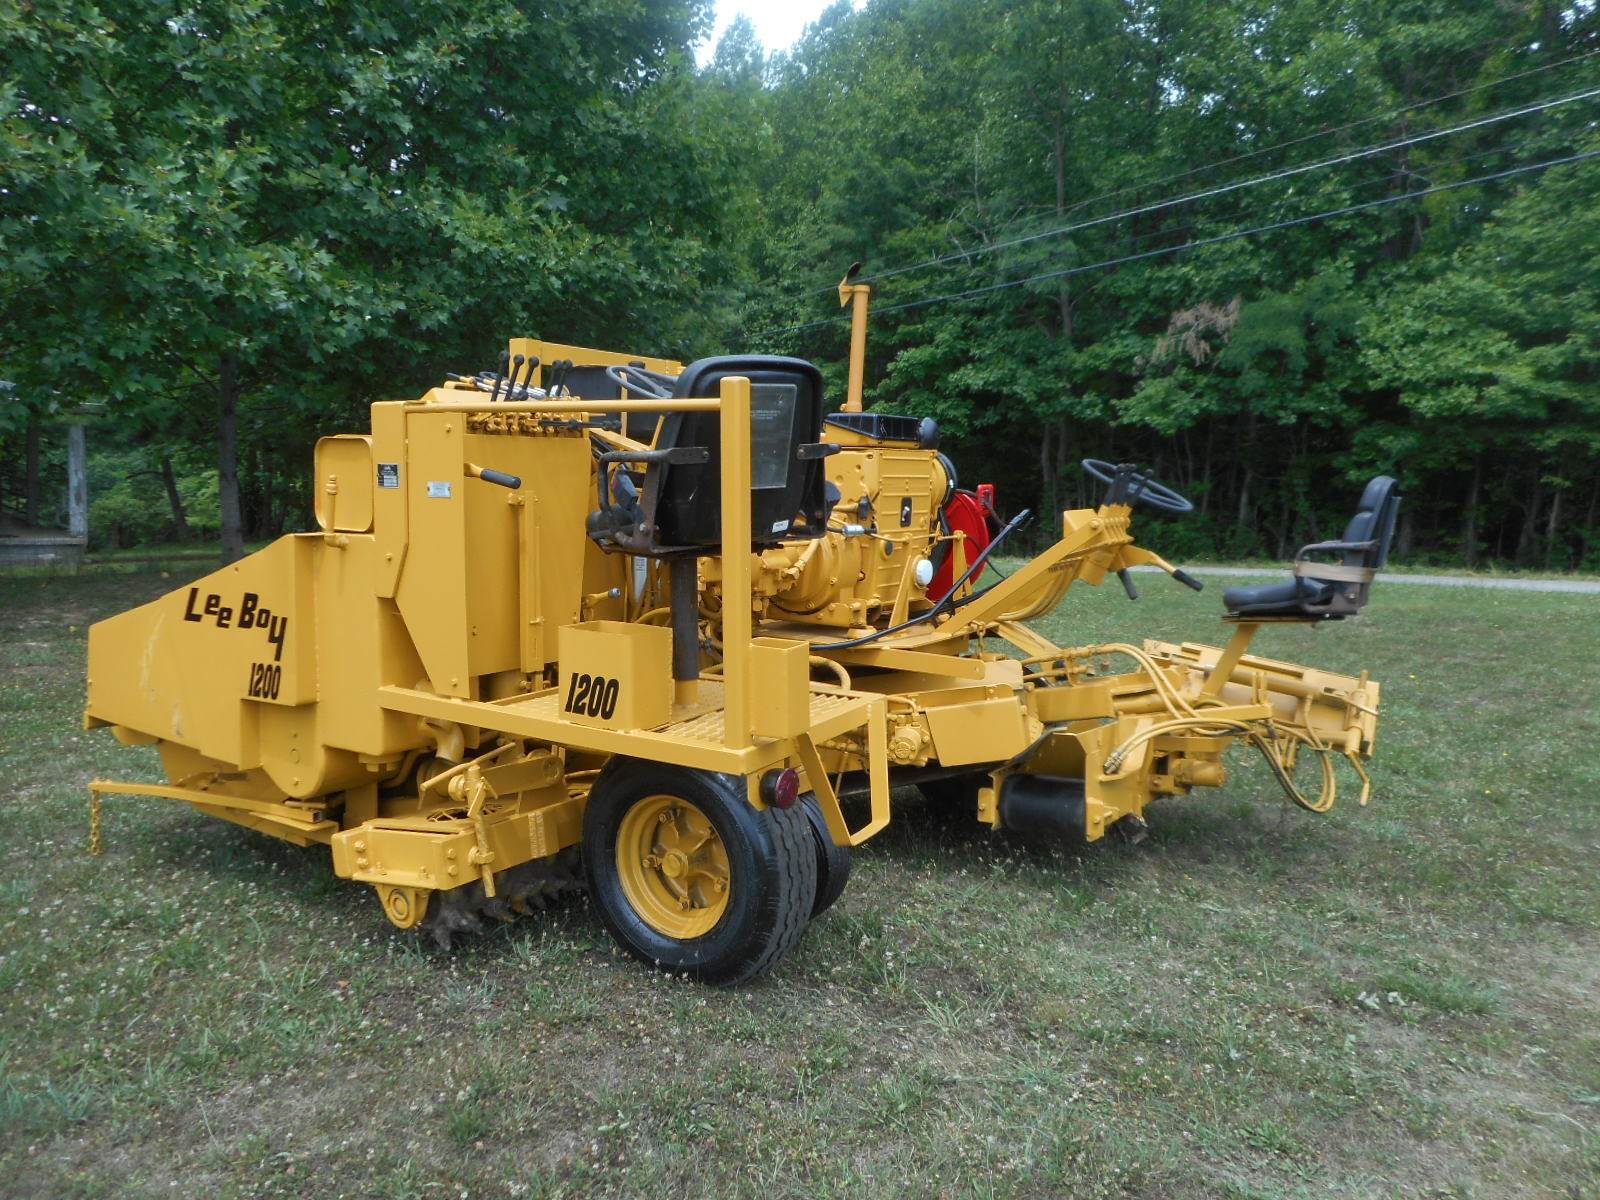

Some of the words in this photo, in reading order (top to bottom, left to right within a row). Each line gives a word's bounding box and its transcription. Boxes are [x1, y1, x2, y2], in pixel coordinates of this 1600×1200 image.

[184, 587, 233, 629] Lee
[238, 592, 288, 662] Boy
[248, 662, 282, 700] 1200
[564, 672, 620, 720] 1200
